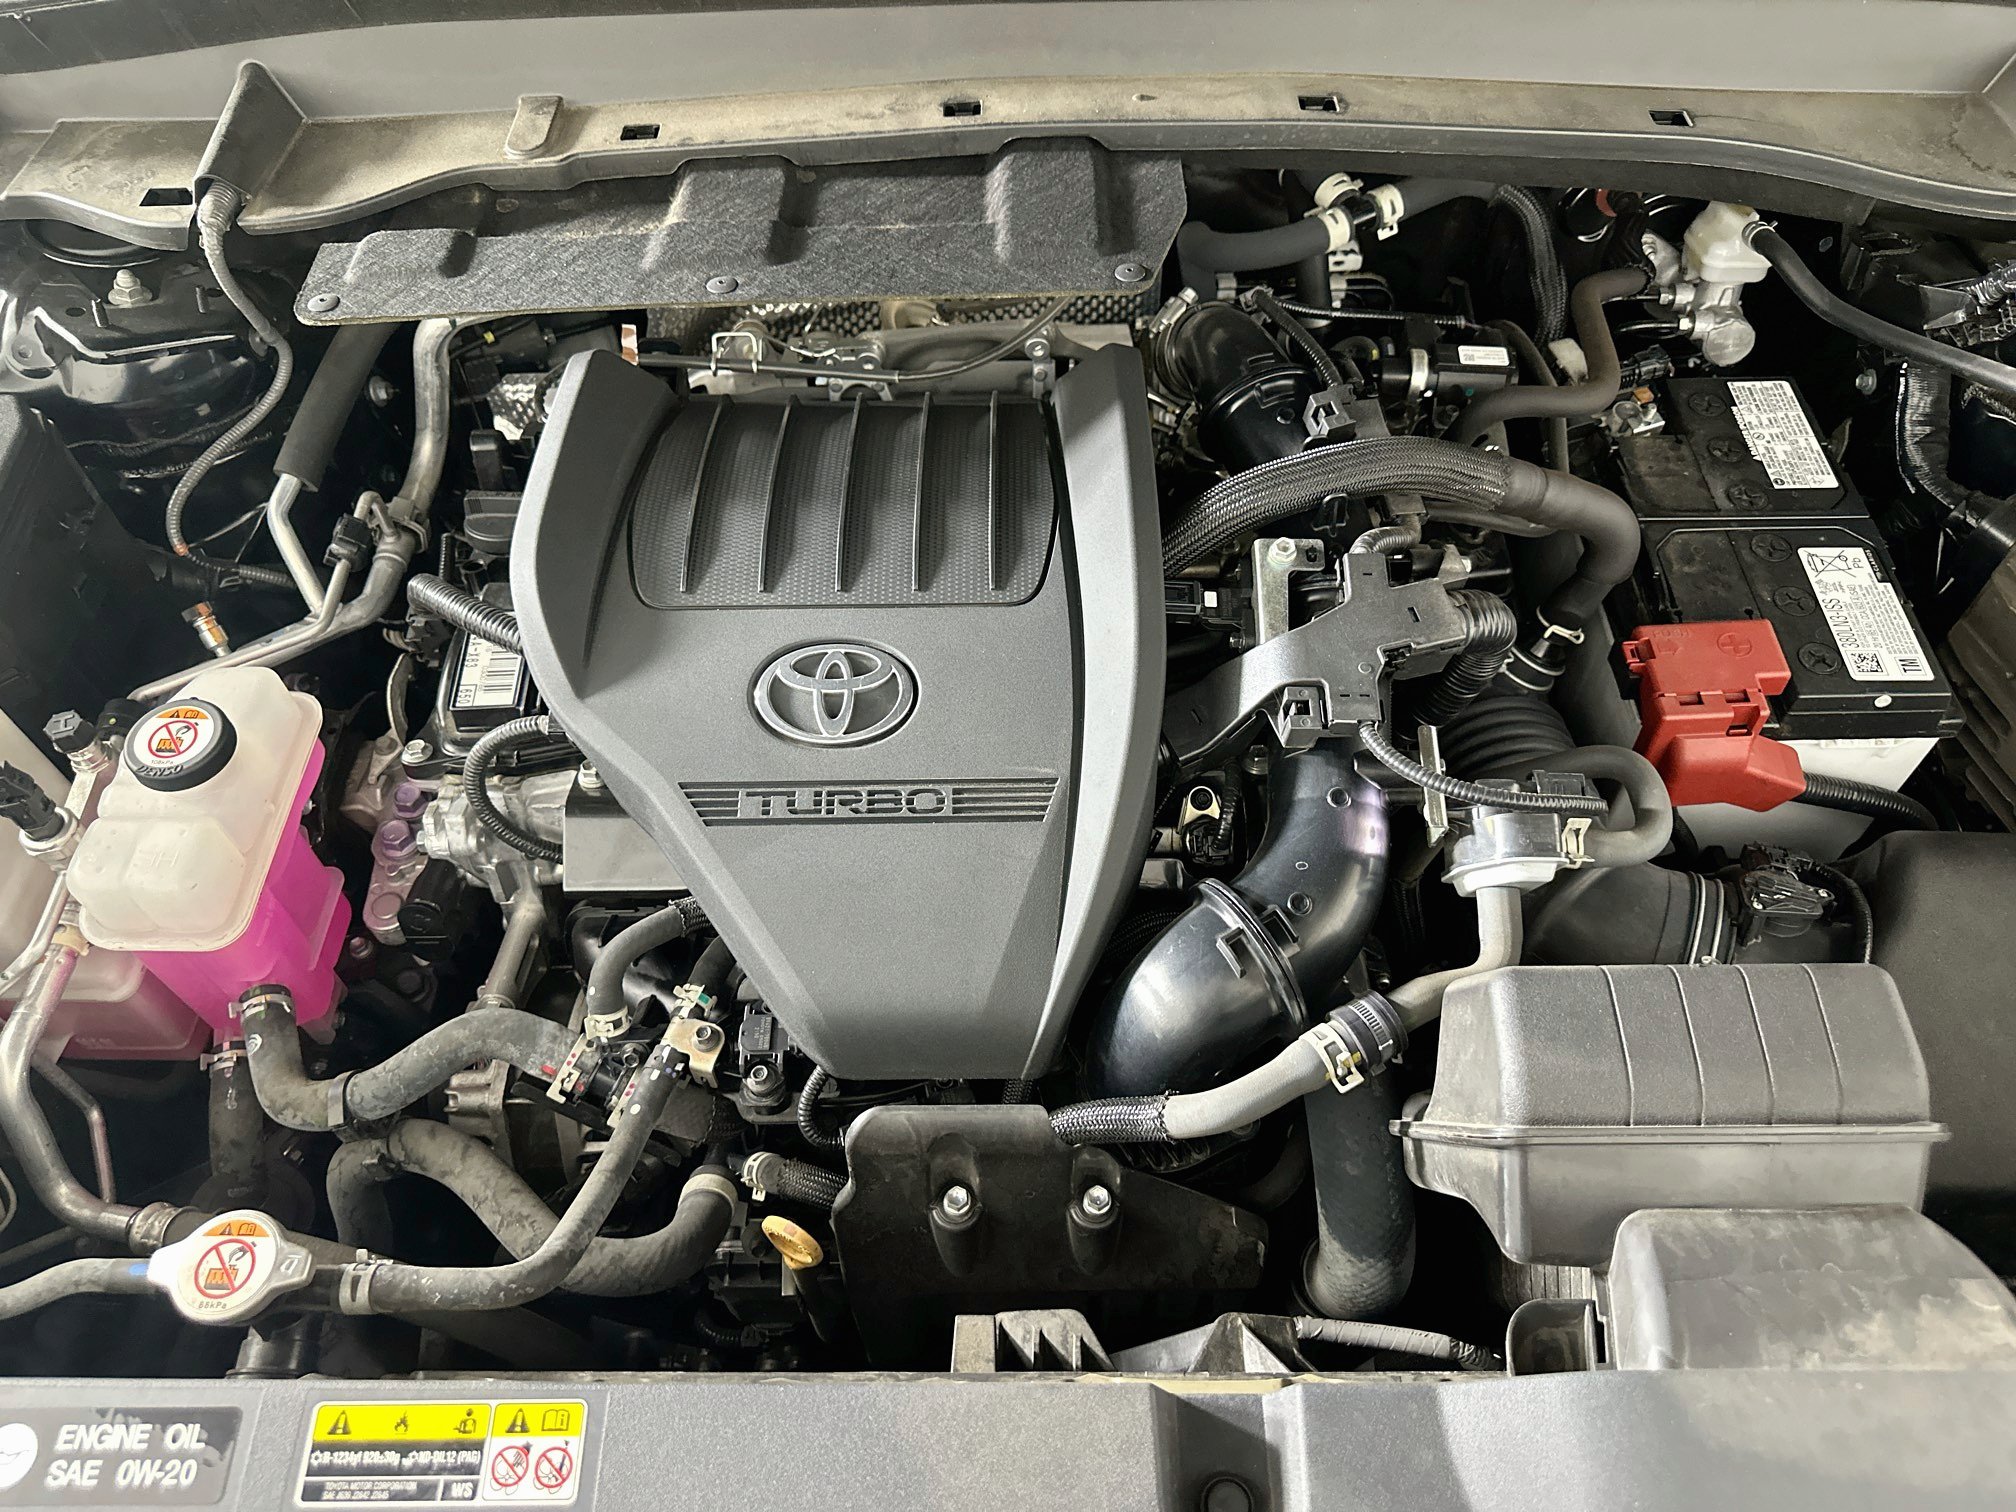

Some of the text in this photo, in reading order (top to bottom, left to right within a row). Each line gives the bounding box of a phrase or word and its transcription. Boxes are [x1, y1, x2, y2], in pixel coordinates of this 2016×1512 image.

[1852, 557, 1864, 568] Pb
[1821, 598, 1860, 648] 380LN3-ISS
[1898, 658, 1922, 673] TM
[457, 688, 473, 704] 650
[136, 764, 184, 777] DENSO
[741, 788, 947, 816] TURBO
[54, 1423, 206, 1450] ENGINE OIL
[457, 1450, 481, 1464] (PAG)
[45, 1458, 198, 1487] SAE 0W-20
[451, 1481, 474, 1498] WS
